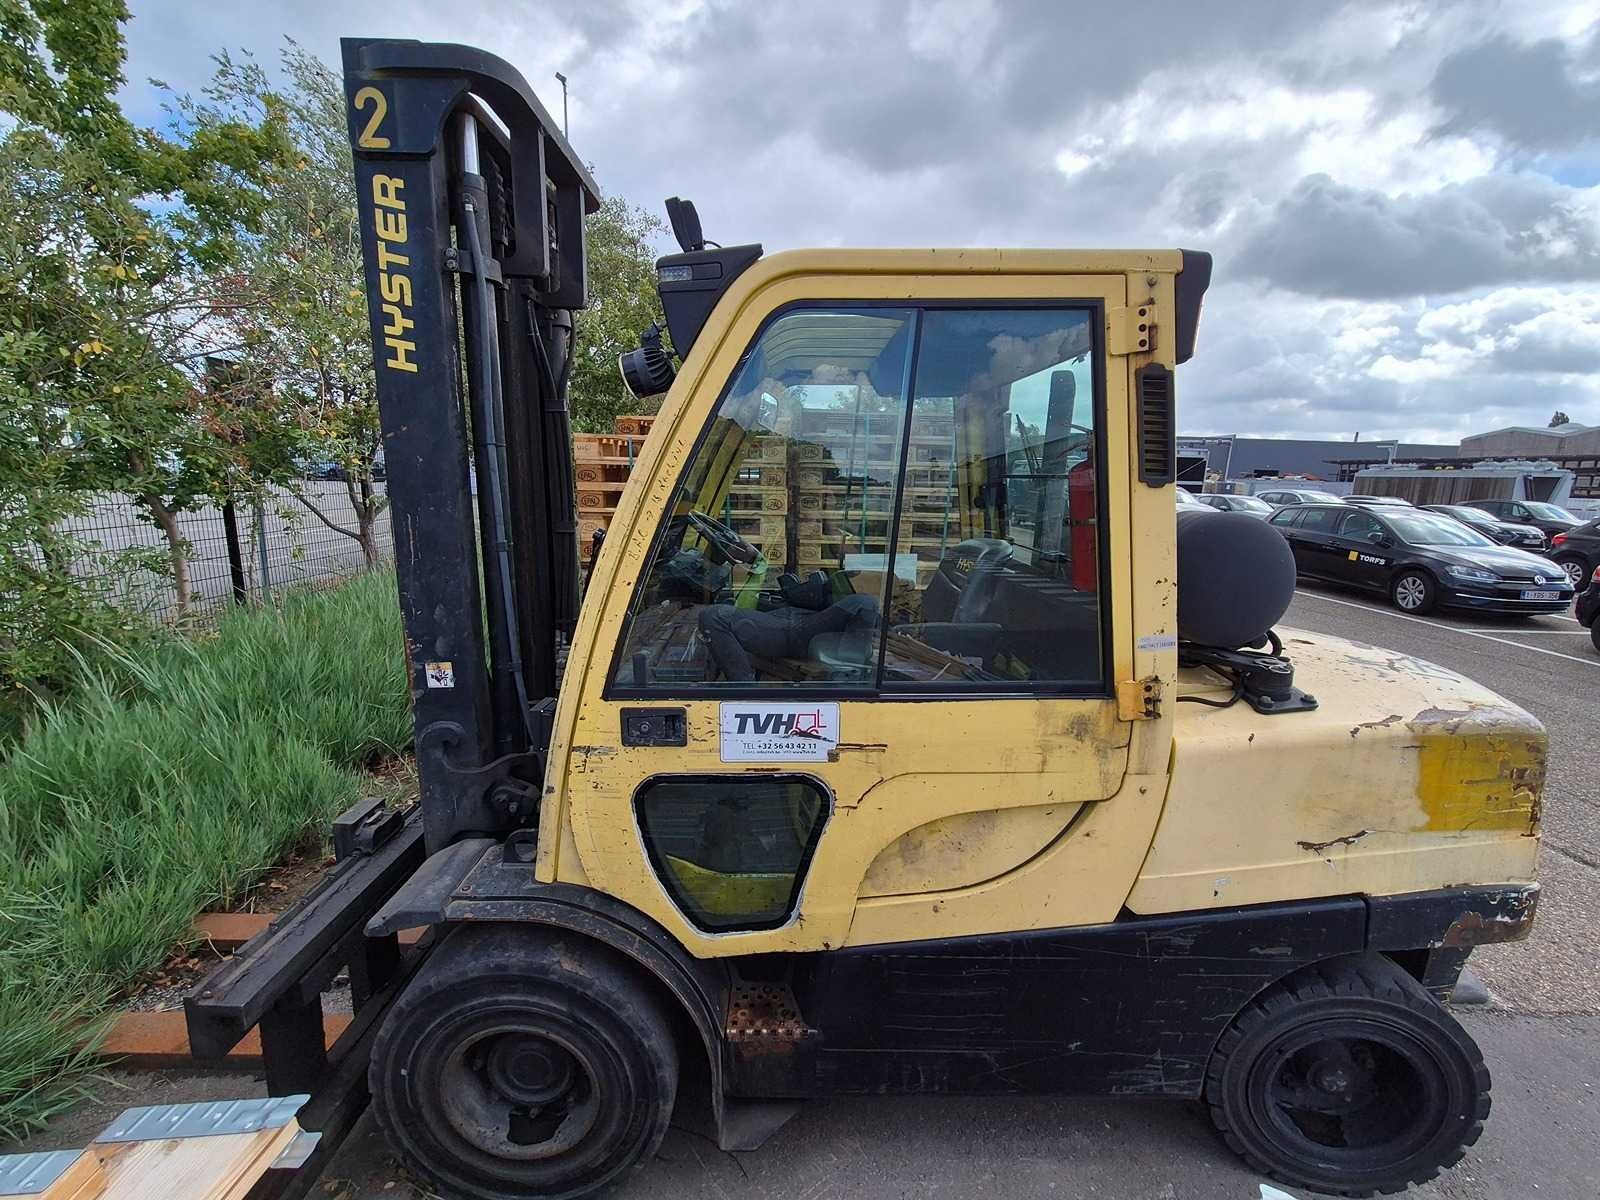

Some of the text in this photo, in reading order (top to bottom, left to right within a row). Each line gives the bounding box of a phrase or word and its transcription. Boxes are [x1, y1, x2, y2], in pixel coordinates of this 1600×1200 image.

[354, 86, 391, 149] 2
[372, 174, 418, 373] HYSTER
[1360, 554, 1386, 565] TORFS
[734, 713, 796, 735] TVH
